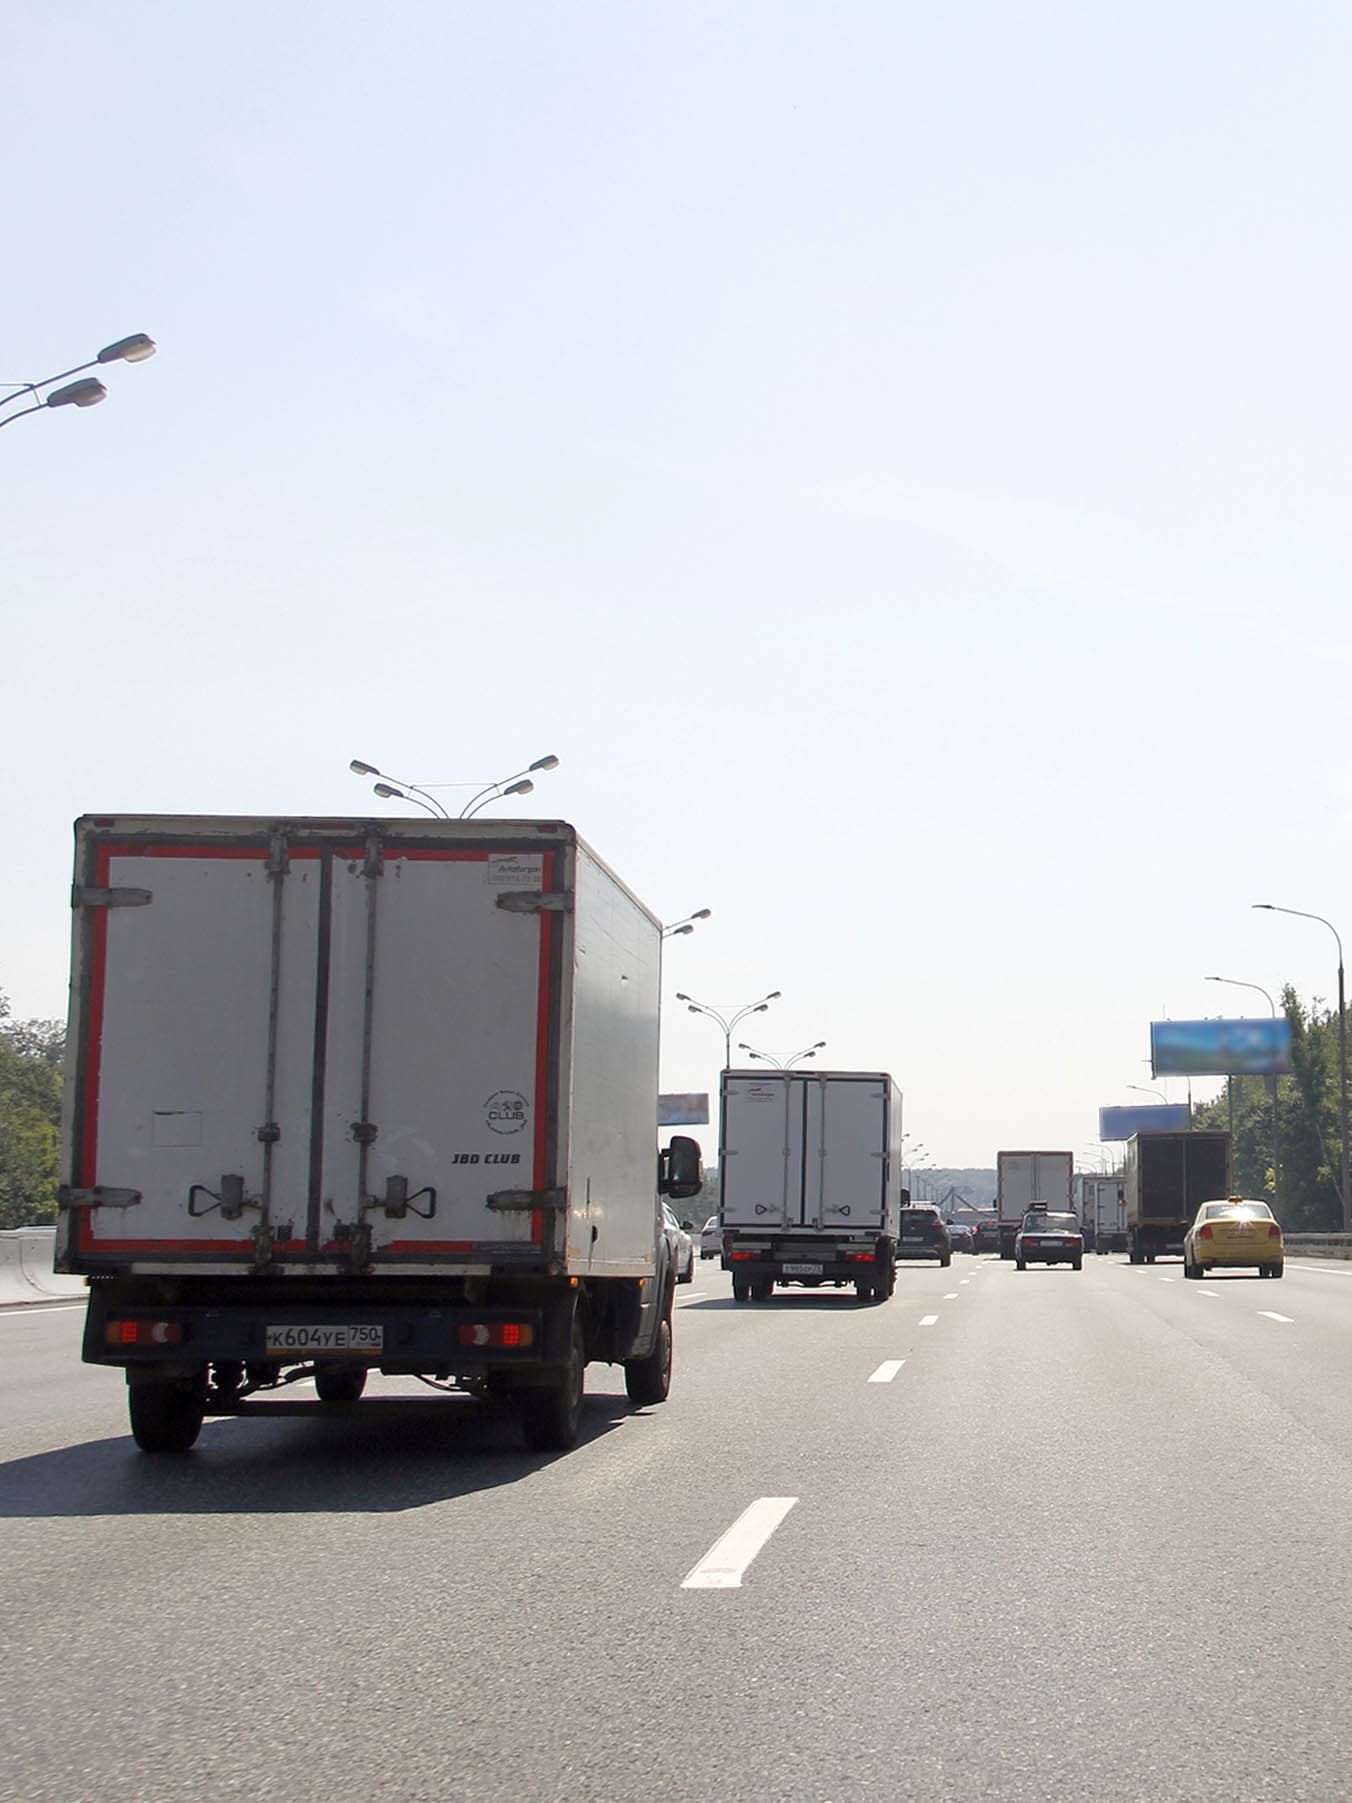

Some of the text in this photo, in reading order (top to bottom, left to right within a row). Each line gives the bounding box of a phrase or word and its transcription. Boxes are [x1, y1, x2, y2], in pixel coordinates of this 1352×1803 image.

[488, 1111, 524, 1120] CLUB
[484, 1153, 521, 1165] CLUB
[272, 1327, 379, 1347] К604УЕ 750
